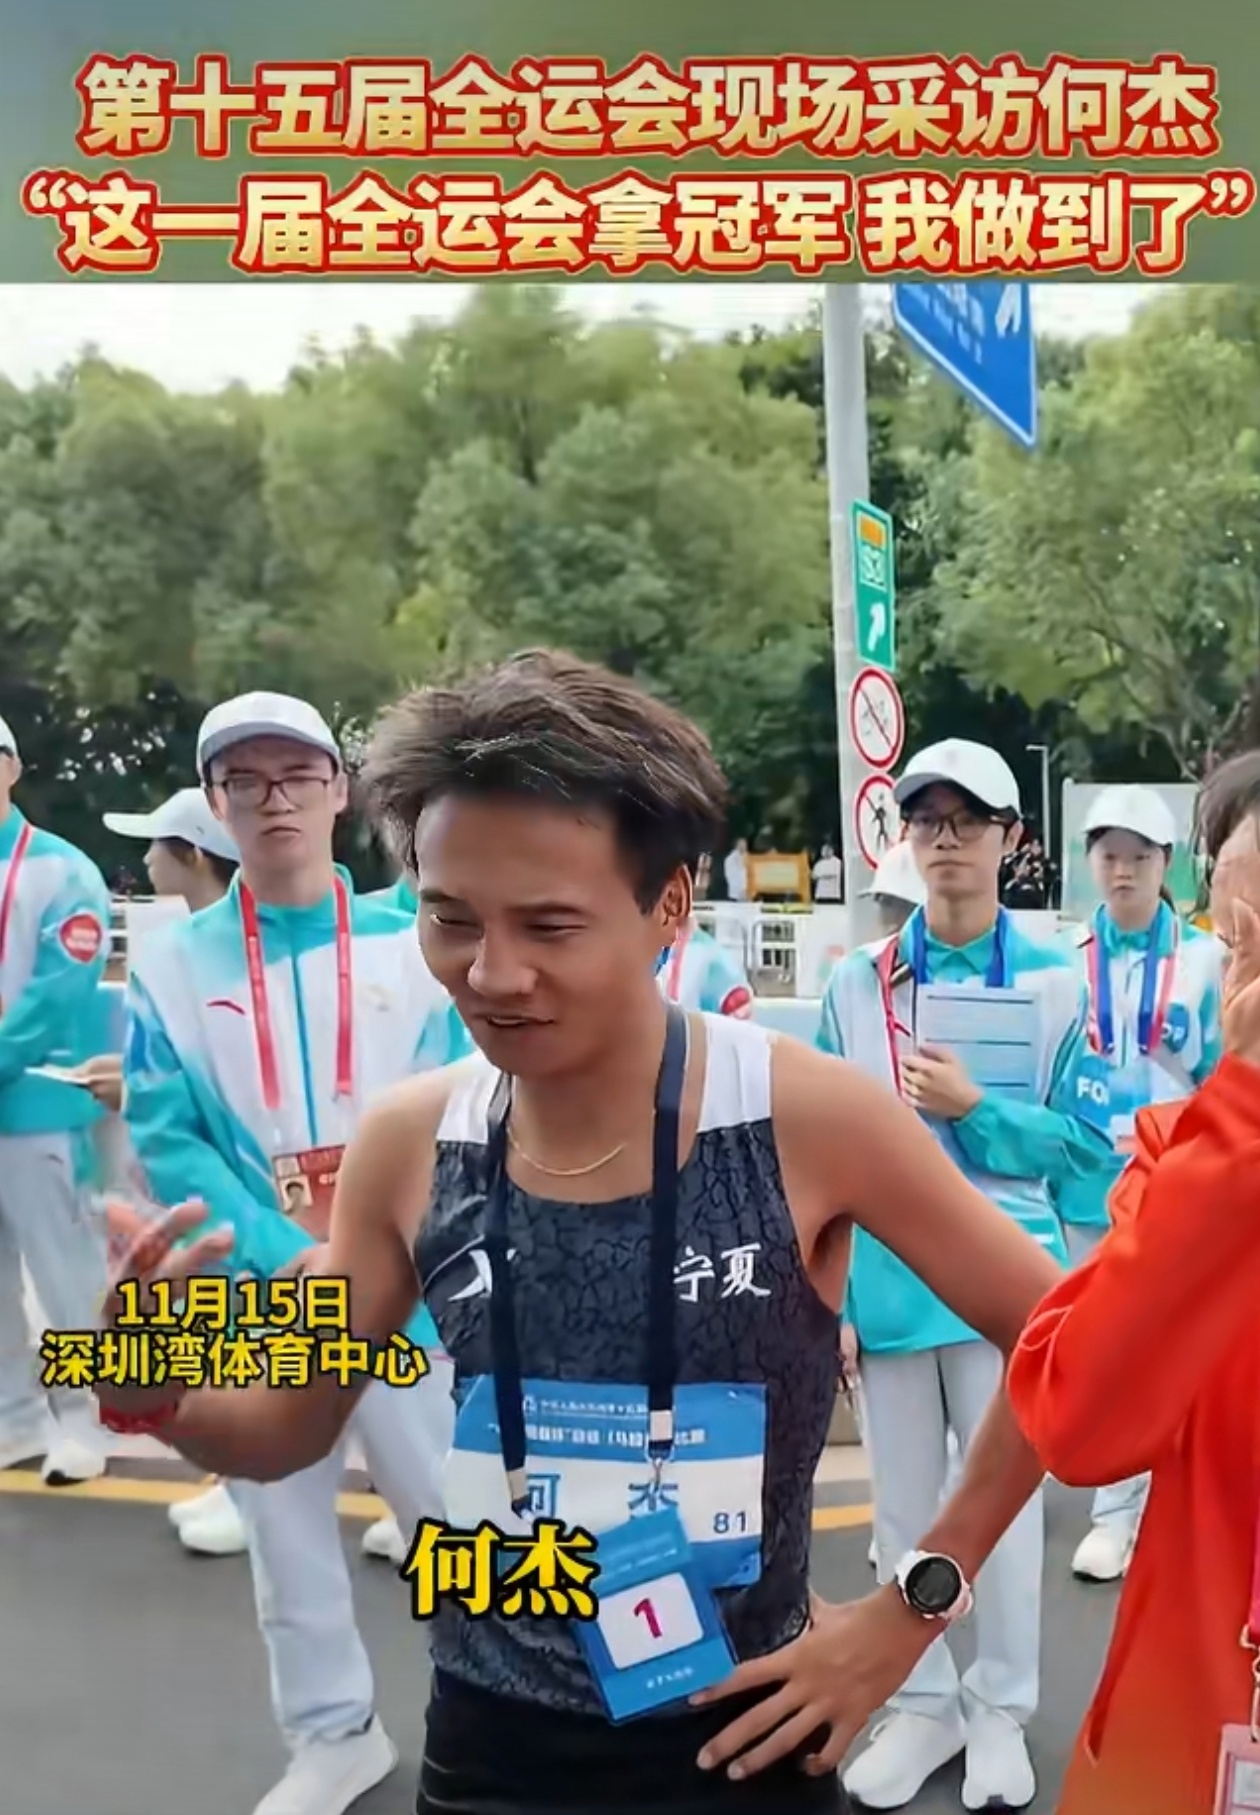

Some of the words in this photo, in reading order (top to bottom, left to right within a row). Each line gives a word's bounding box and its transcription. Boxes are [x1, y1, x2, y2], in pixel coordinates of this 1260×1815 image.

[673, 1243, 772, 1302] 宁夏
[713, 1511, 748, 1534] 81
[634, 1597, 662, 1639] 1
